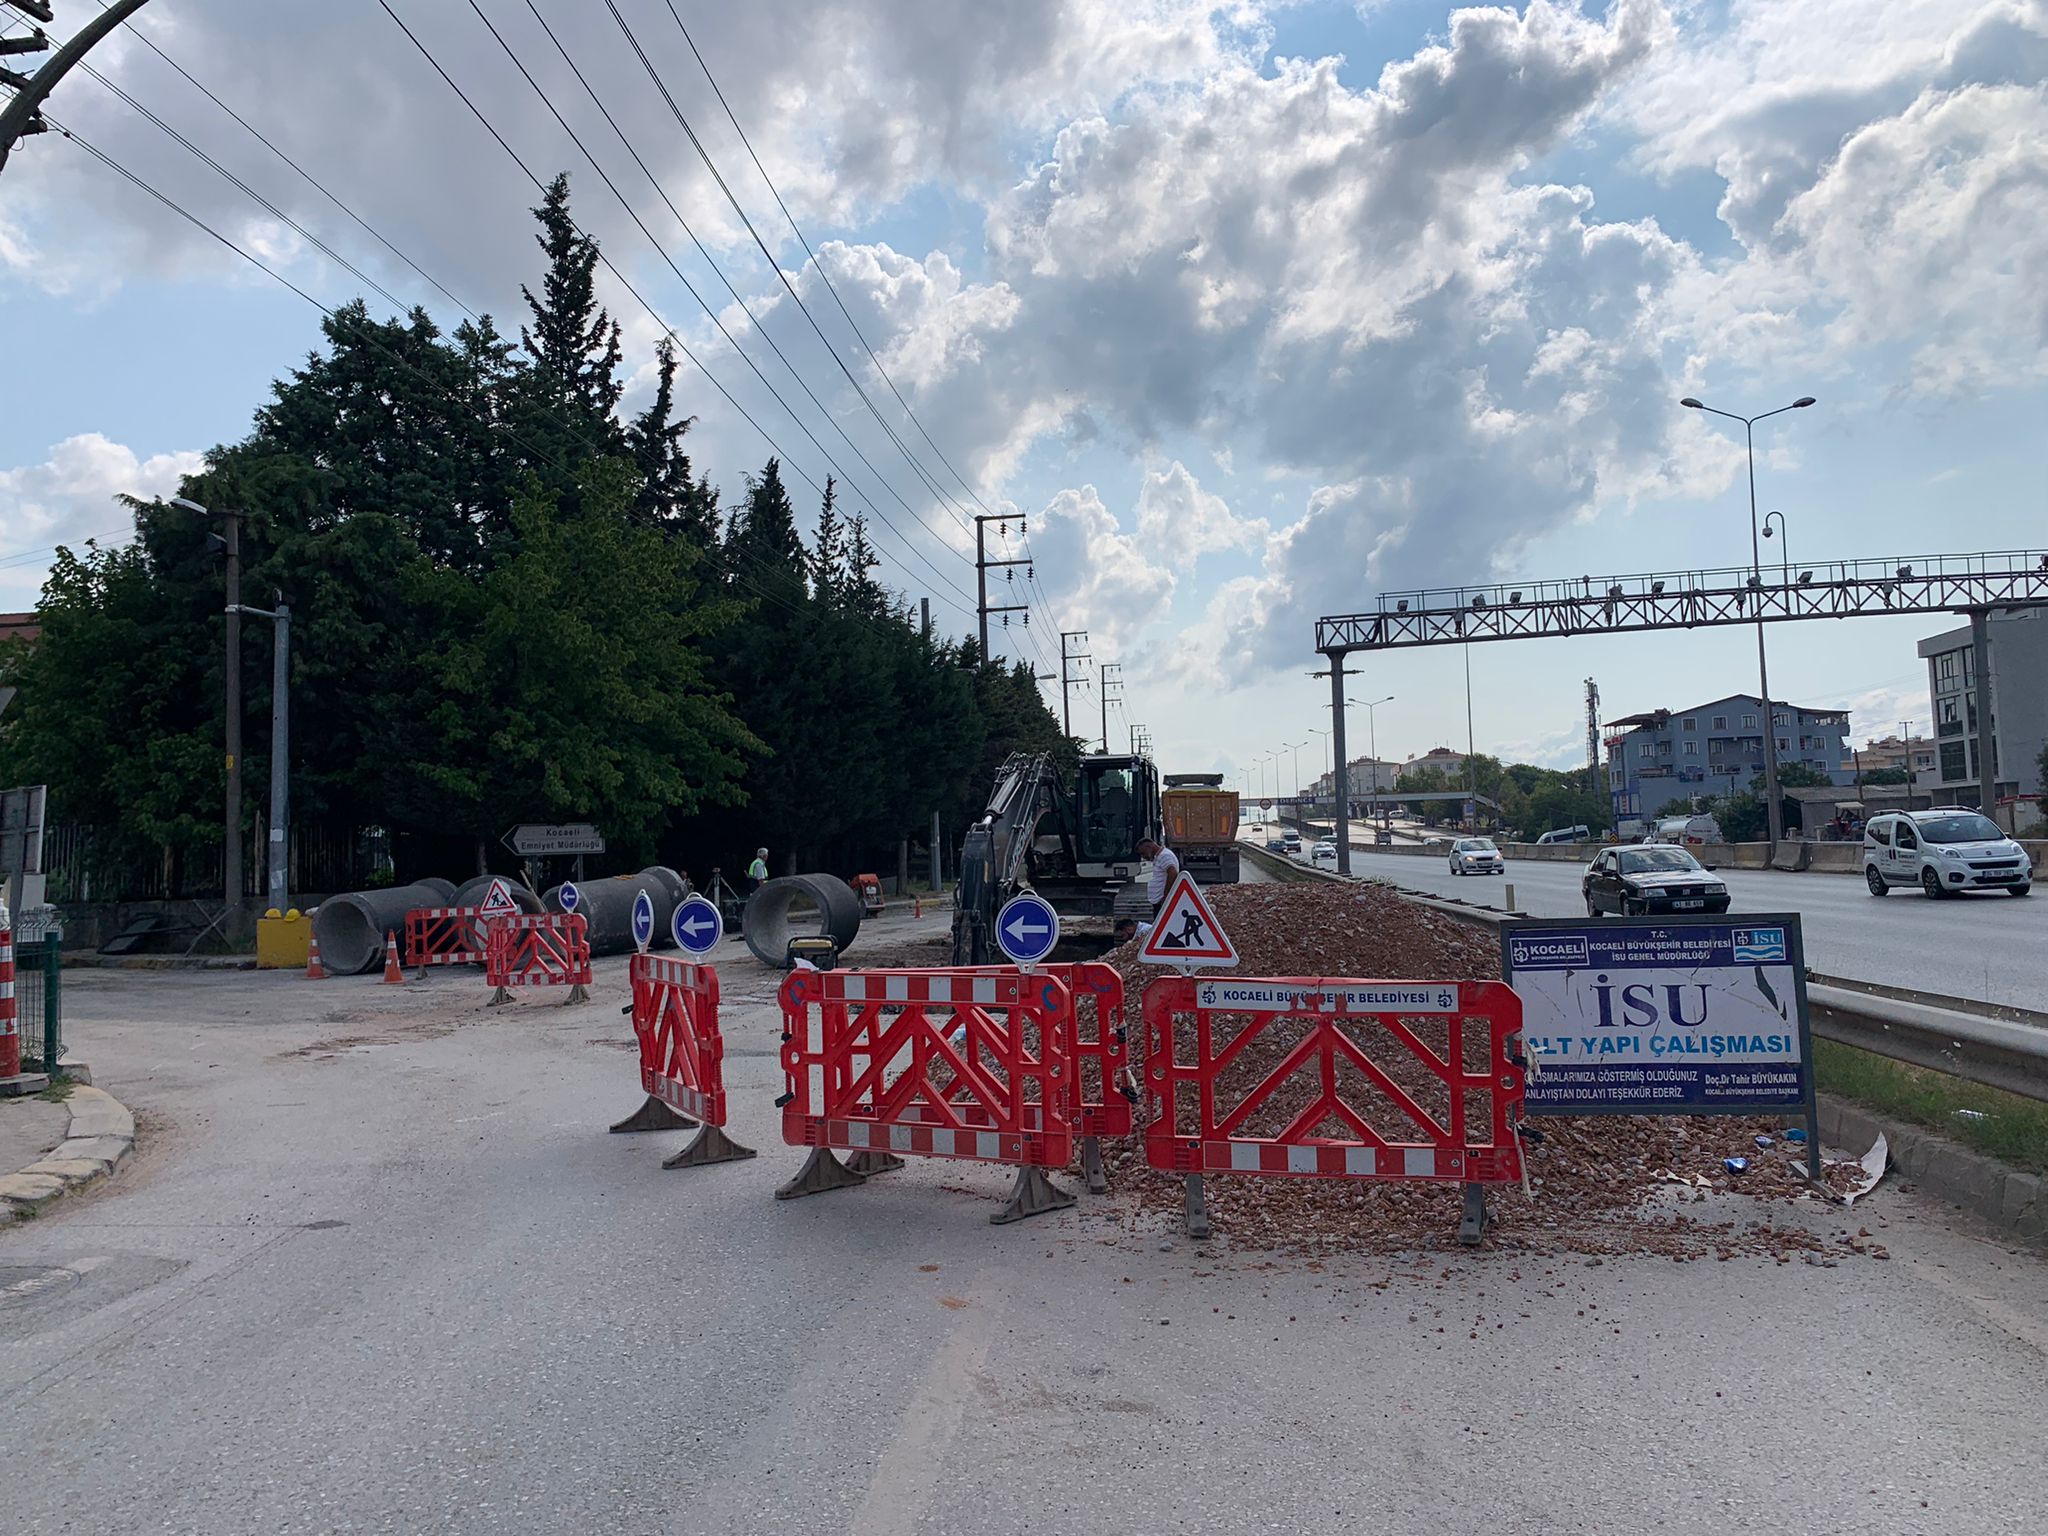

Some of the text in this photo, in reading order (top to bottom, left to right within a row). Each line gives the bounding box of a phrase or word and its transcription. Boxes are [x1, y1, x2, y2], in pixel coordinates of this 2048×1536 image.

[546, 828, 580, 836] Kocaeli
[521, 842, 554, 850] Emniyet
[1651, 930, 1668, 938] T.C.
[1754, 931, 1780, 944] İSU
[1530, 942, 1585, 955] KOCAELİ
[1589, 938, 1731, 951] KOCAELİ BÜYÜKŞEHİR BELEDİYESİ
[1612, 950, 1710, 961] İSU GENEL MÜDÜRLÜĞÜ
[1223, 989, 1273, 1001] KOCAELİ
[1359, 990, 1430, 1004] BELEDİYESİ
[1591, 974, 1712, 1027] İSU
[1581, 1036, 1640, 1054] YAPI
[1649, 1035, 1791, 1057] ÇALIŞMASI
[1598, 1068, 1645, 1083] GÖSTERMİŞ
[1646, 1068, 1698, 1081] OLDUĞUNUZ
[1731, 1074, 1750, 1084] Tahir
[1752, 1072, 1797, 1084] BÜYÜKAKIN
[1525, 1088, 1575, 1101] ANLAYIŞTAN
[1576, 1088, 1606, 1099] DOLAYI
[1607, 1086, 1652, 1100] TEŞEKKÜR
